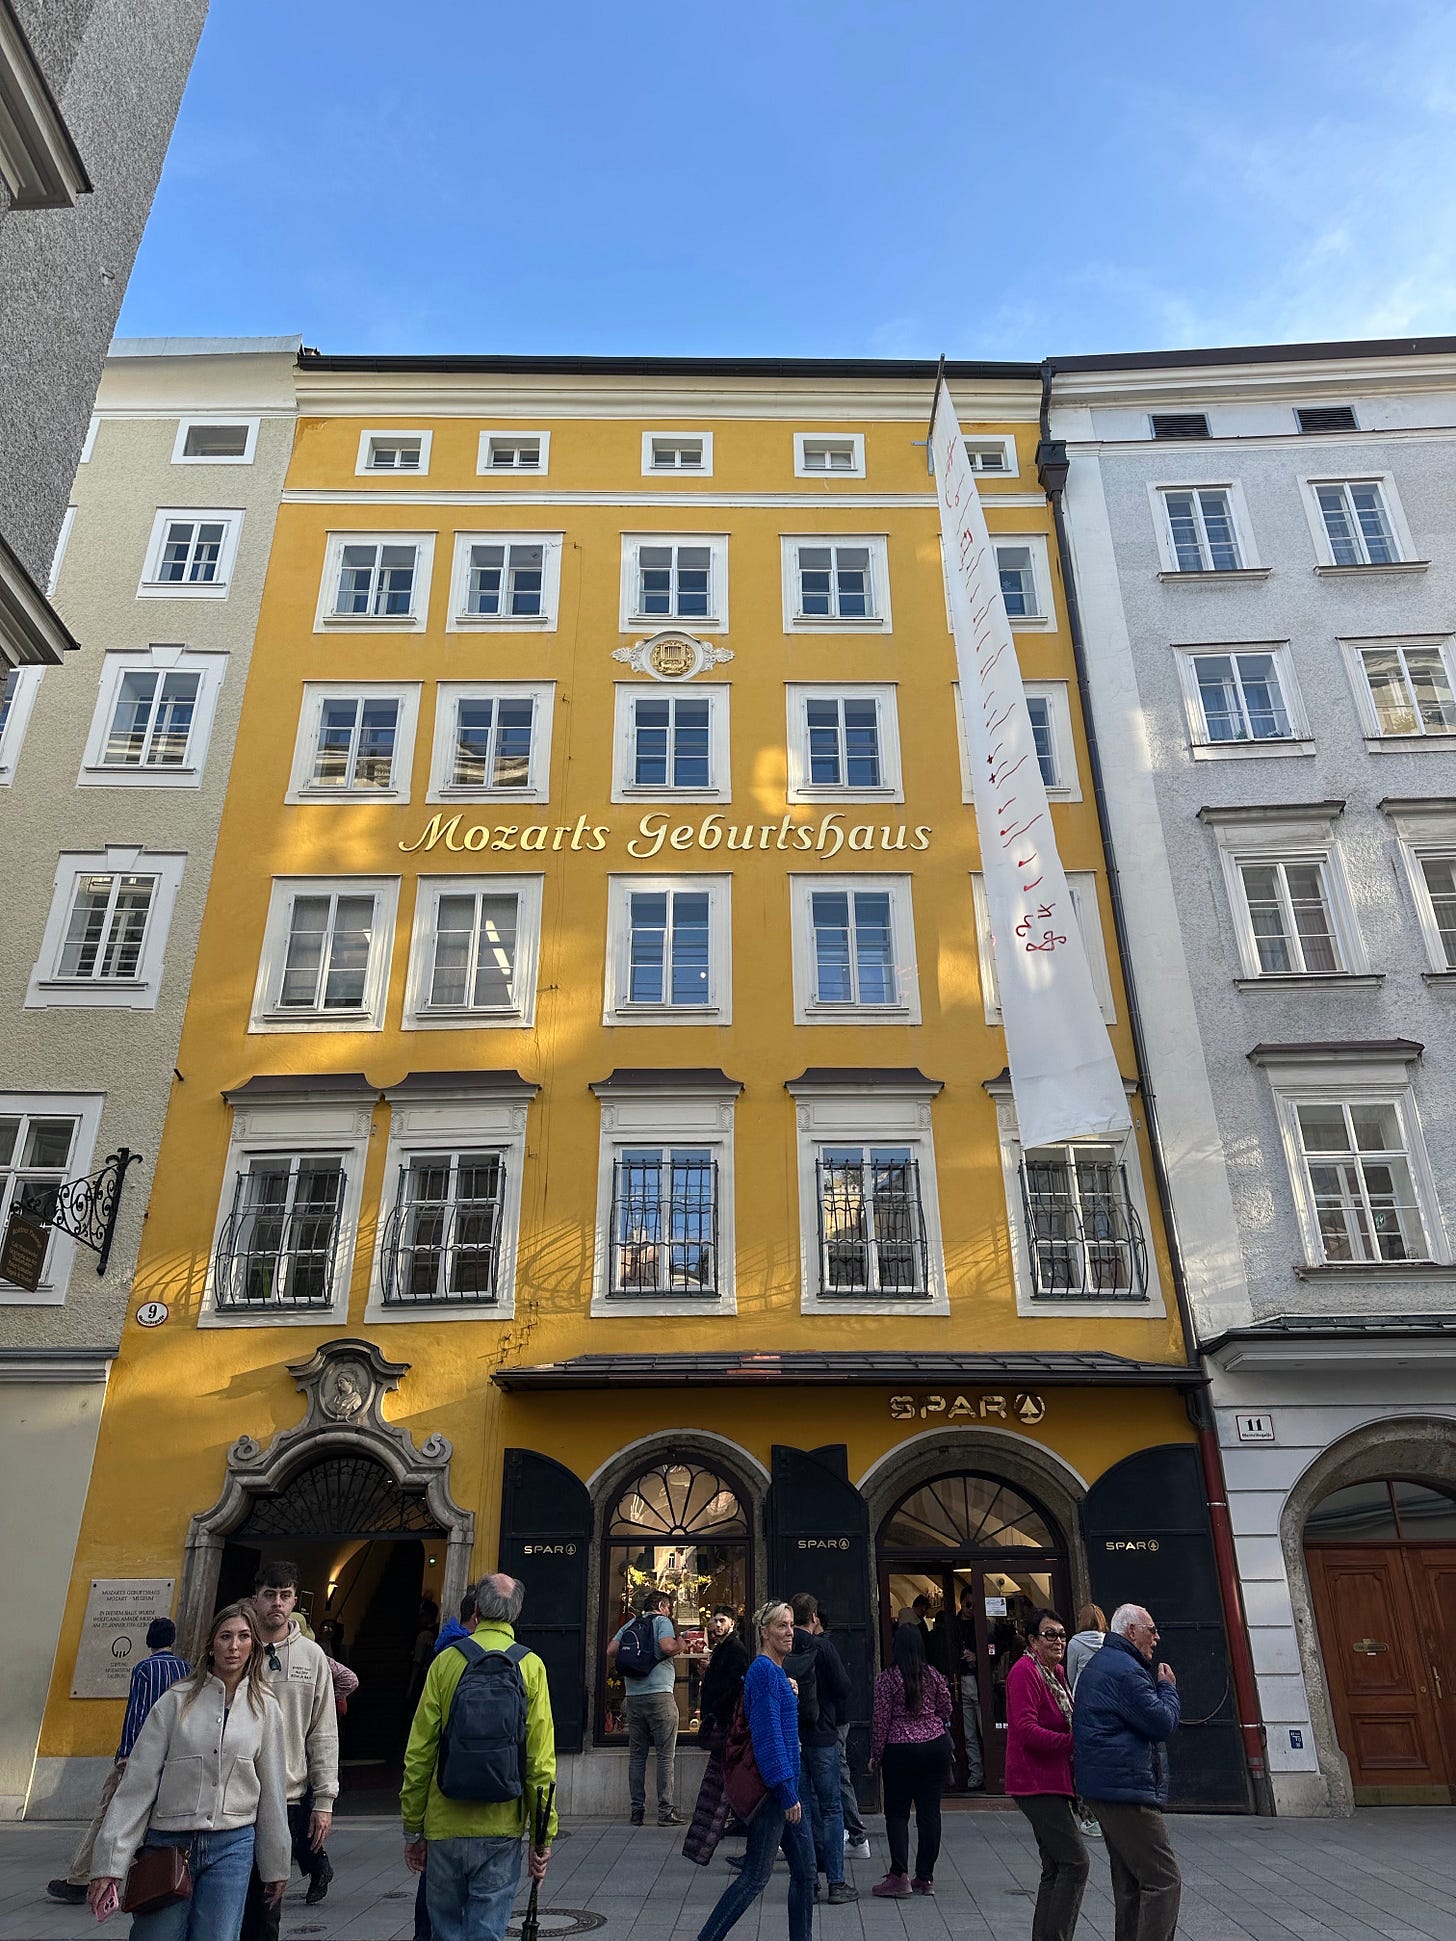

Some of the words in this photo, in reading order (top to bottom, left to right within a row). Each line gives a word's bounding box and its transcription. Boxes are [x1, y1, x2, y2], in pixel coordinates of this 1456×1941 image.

[398, 812, 611, 852] Mozarts
[627, 811, 932, 860] Geburtshaus
[148, 1304, 157, 1319] 9
[889, 1394, 1008, 1419] SPAR
[1245, 1418, 1264, 1431] 11
[523, 1545, 564, 1554] SPAR
[797, 1540, 838, 1549] SPAR
[1105, 1541, 1147, 1551] SPAR
